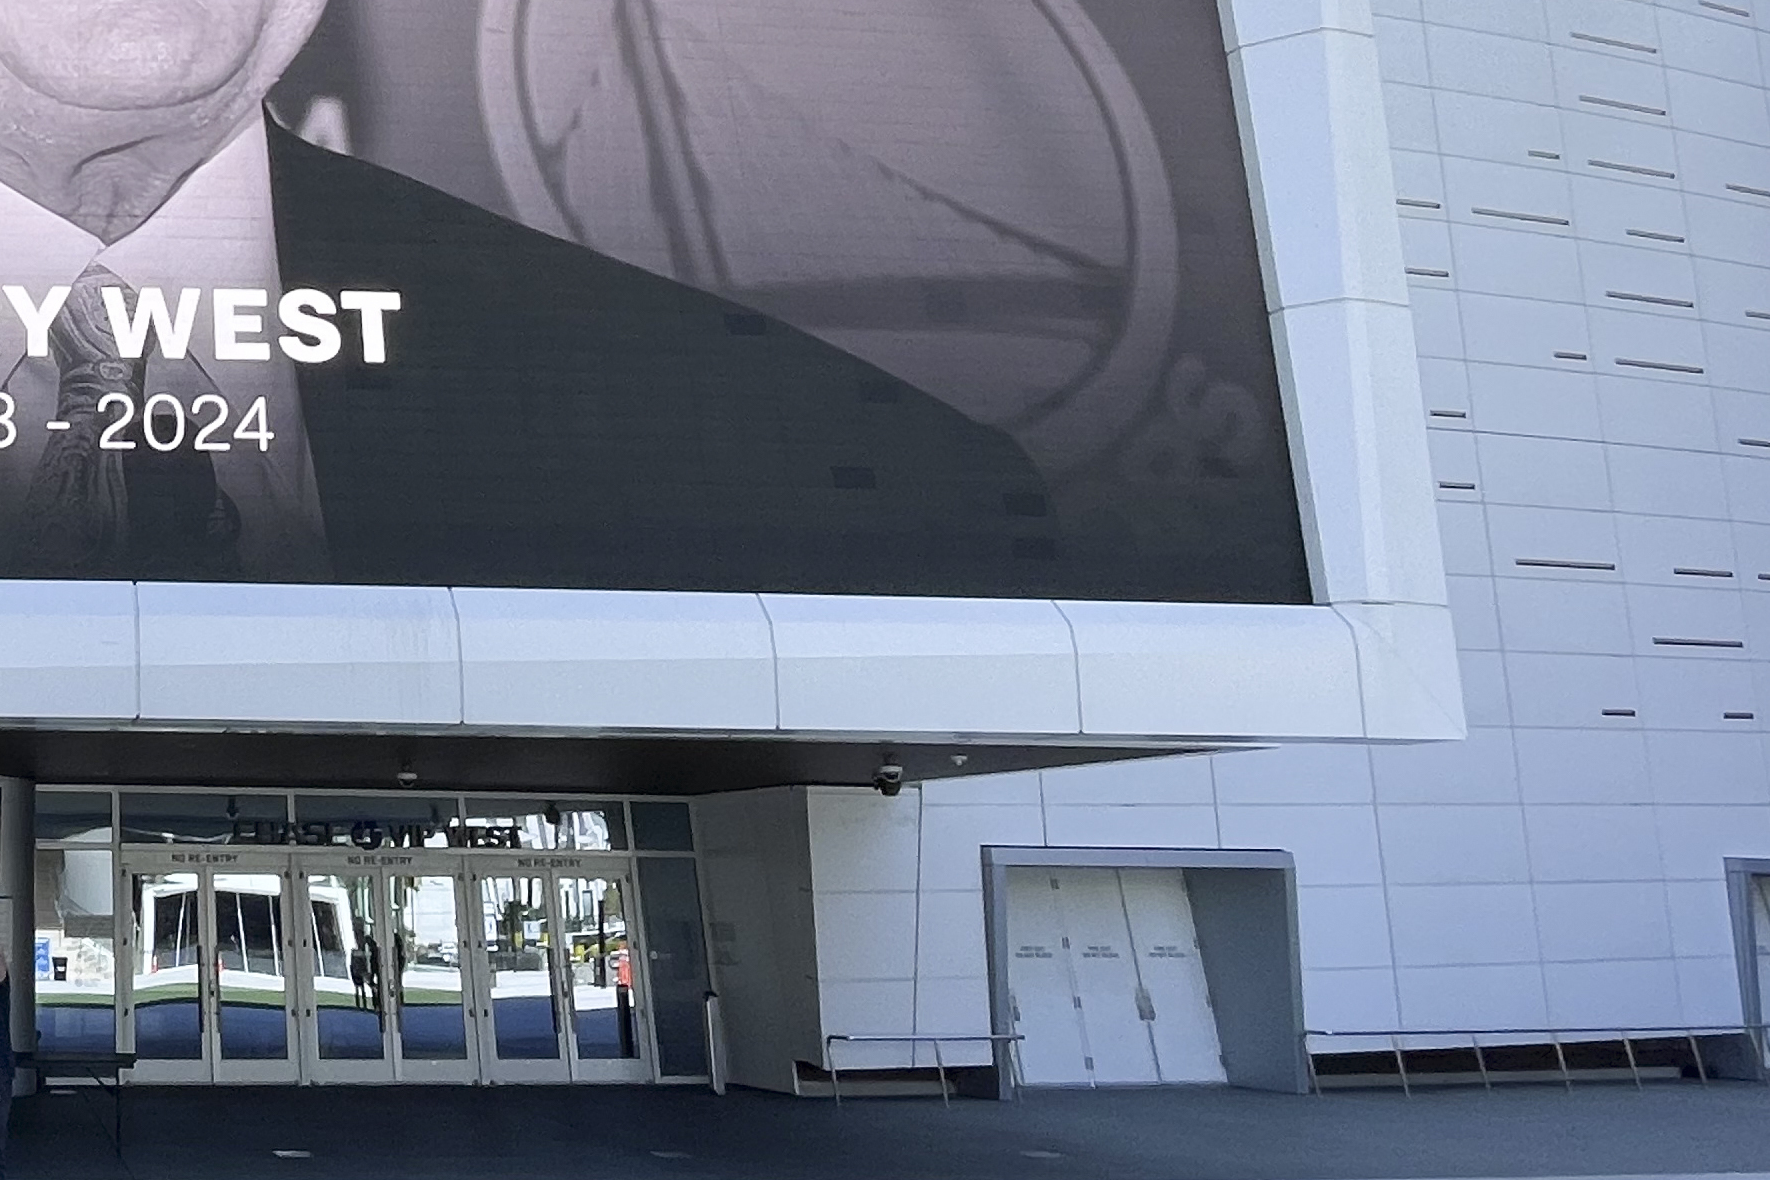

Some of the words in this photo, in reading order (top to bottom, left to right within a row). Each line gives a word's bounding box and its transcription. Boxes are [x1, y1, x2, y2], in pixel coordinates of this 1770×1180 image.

[101, 286, 402, 364] WEST
[96, 394, 276, 453] 2024
[187, 854, 238, 864] RE-ENTRY
[362, 856, 413, 866] RE-ENTRY
